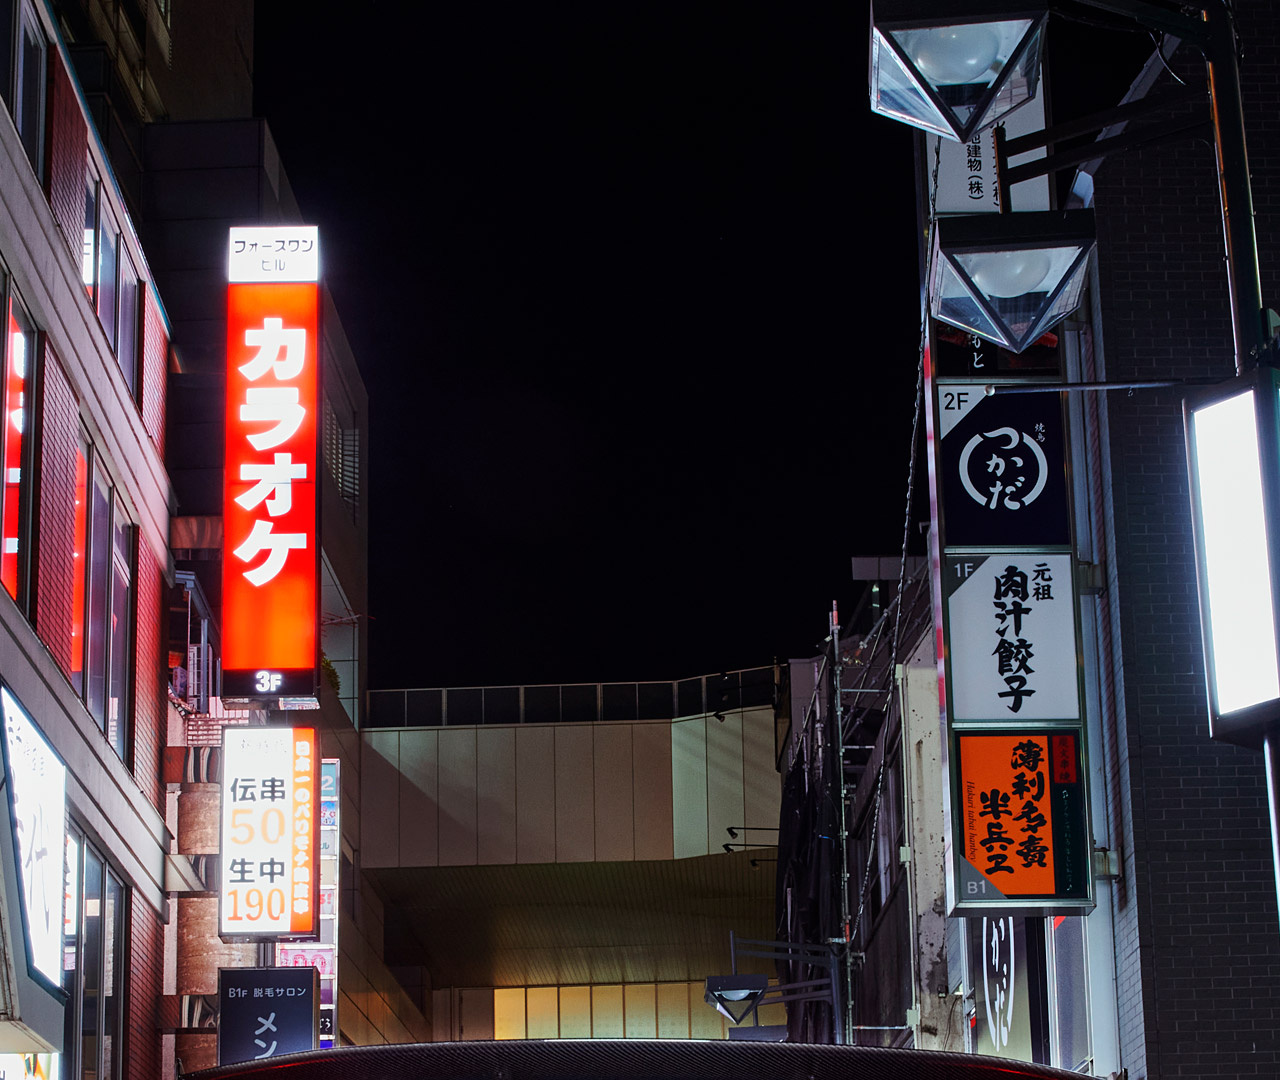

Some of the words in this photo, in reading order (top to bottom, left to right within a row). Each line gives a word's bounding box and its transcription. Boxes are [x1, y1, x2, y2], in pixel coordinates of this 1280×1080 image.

[944, 392, 969, 410] 2F
[233, 317, 307, 587] カラオケ
[982, 426, 1026, 511] つかだ
[954, 563, 974, 578] 1F
[1032, 562, 1054, 601] 元祖
[991, 565, 1036, 713] 肉汁餃子
[255, 671, 282, 692] 3F
[230, 777, 287, 803] 伝串
[230, 807, 287, 846] 50
[228, 857, 286, 885] 生中
[967, 880, 987, 894] B1
[226, 887, 287, 921] 190
[253, 987, 307, 998] 脱毛サロン
